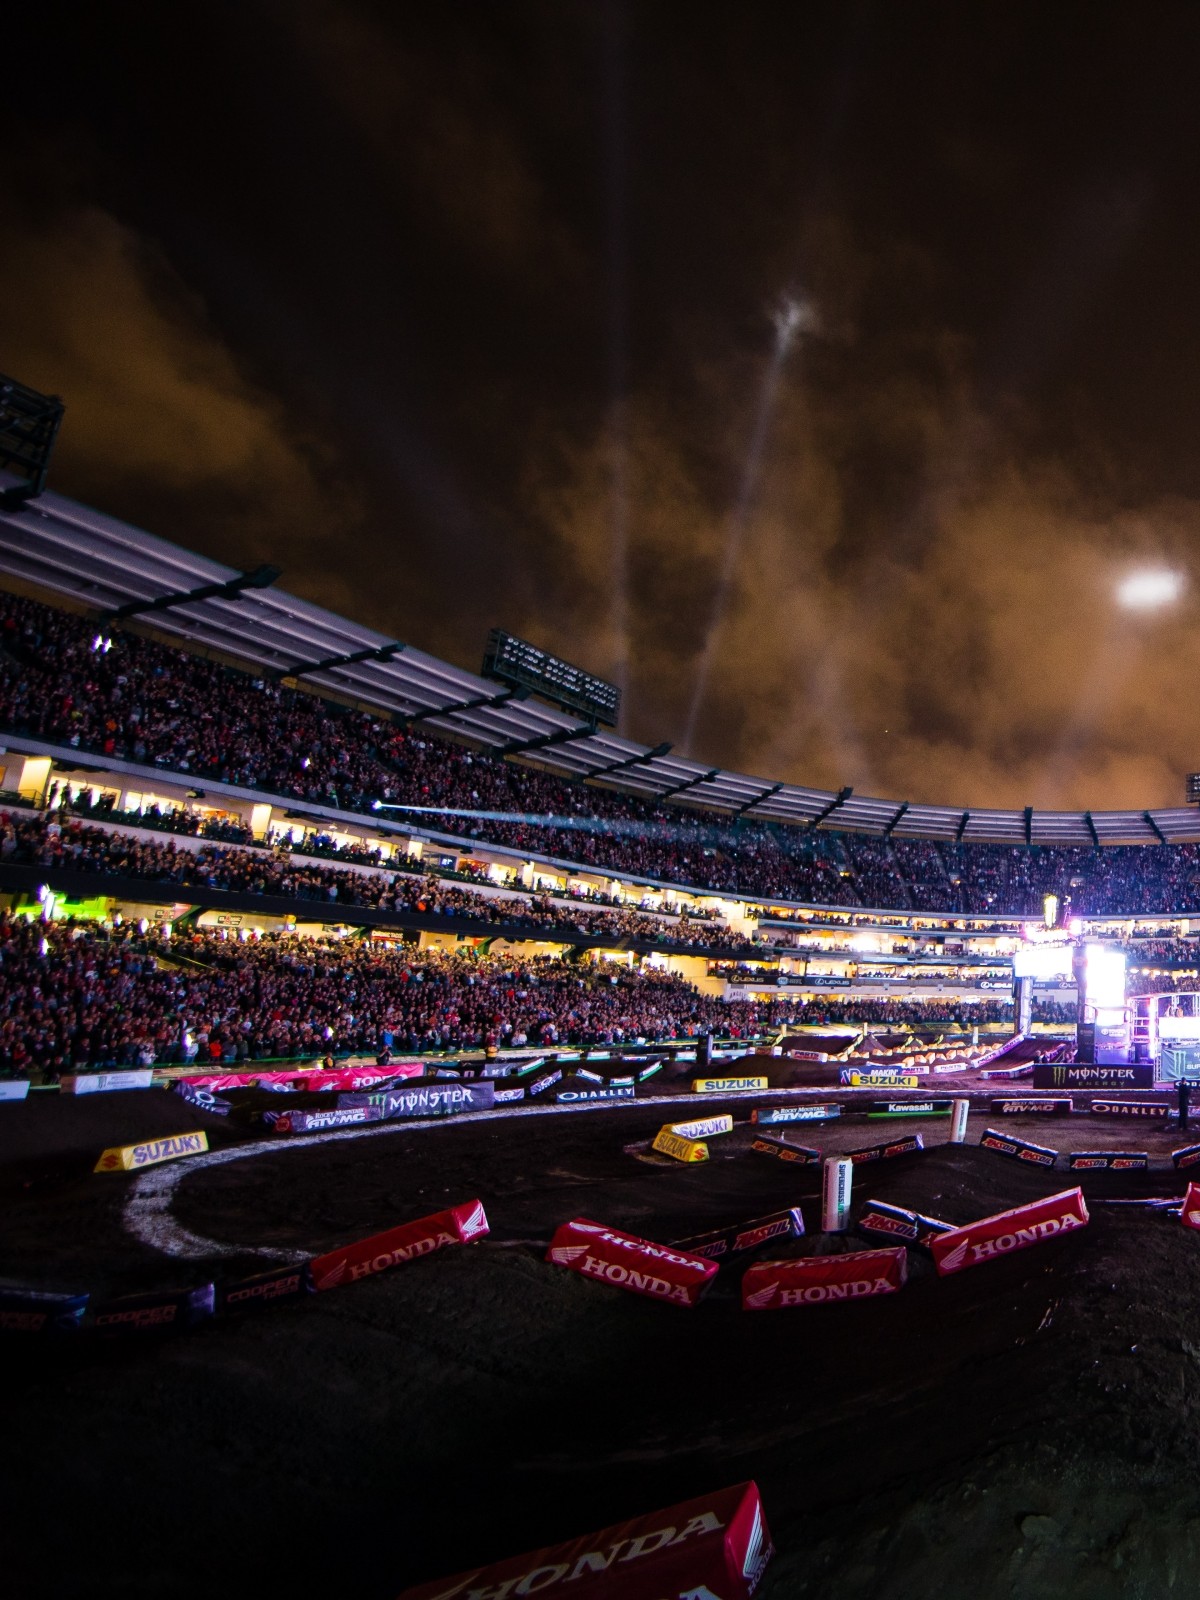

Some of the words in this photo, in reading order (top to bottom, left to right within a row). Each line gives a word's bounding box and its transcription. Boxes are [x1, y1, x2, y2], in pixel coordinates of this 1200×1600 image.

[705, 1079, 761, 1091] SUZUKI
[859, 1076, 912, 1086] SUZUKI
[1068, 1068, 1135, 1080] MONSTER
[389, 1088, 474, 1111] MONSTER
[579, 1088, 633, 1099] OAKLEY
[888, 1103, 934, 1112] Kawasaki
[1111, 1105, 1168, 1116] OAKLEY
[680, 1119, 728, 1138] SUZUKI
[133, 1135, 201, 1164] SUZUKI
[656, 1132, 692, 1160] SUZUKI
[981, 1136, 1018, 1155] AMSOIL
[1017, 1149, 1055, 1166] AMSOIL
[1071, 1158, 1108, 1169] AMSOIL
[1109, 1158, 1147, 1169] AMSOIL
[732, 1218, 791, 1252] AMSOIL
[859, 1212, 919, 1240] AMSOIL
[970, 1212, 1084, 1261] HONDA
[349, 1231, 460, 1282] HONDA
[598, 1232, 707, 1272] HONDA
[226, 1275, 301, 1304] COOPER
[580, 1255, 693, 1304] HONDA
[779, 1277, 898, 1305] HONDA
[262, 1286, 300, 1301] TIRES
[95, 1304, 179, 1327] COOPER
[134, 1315, 176, 1328] TIRES
[464, 1511, 727, 1600] HONDA
[746, 1542, 776, 1597] HONDA
